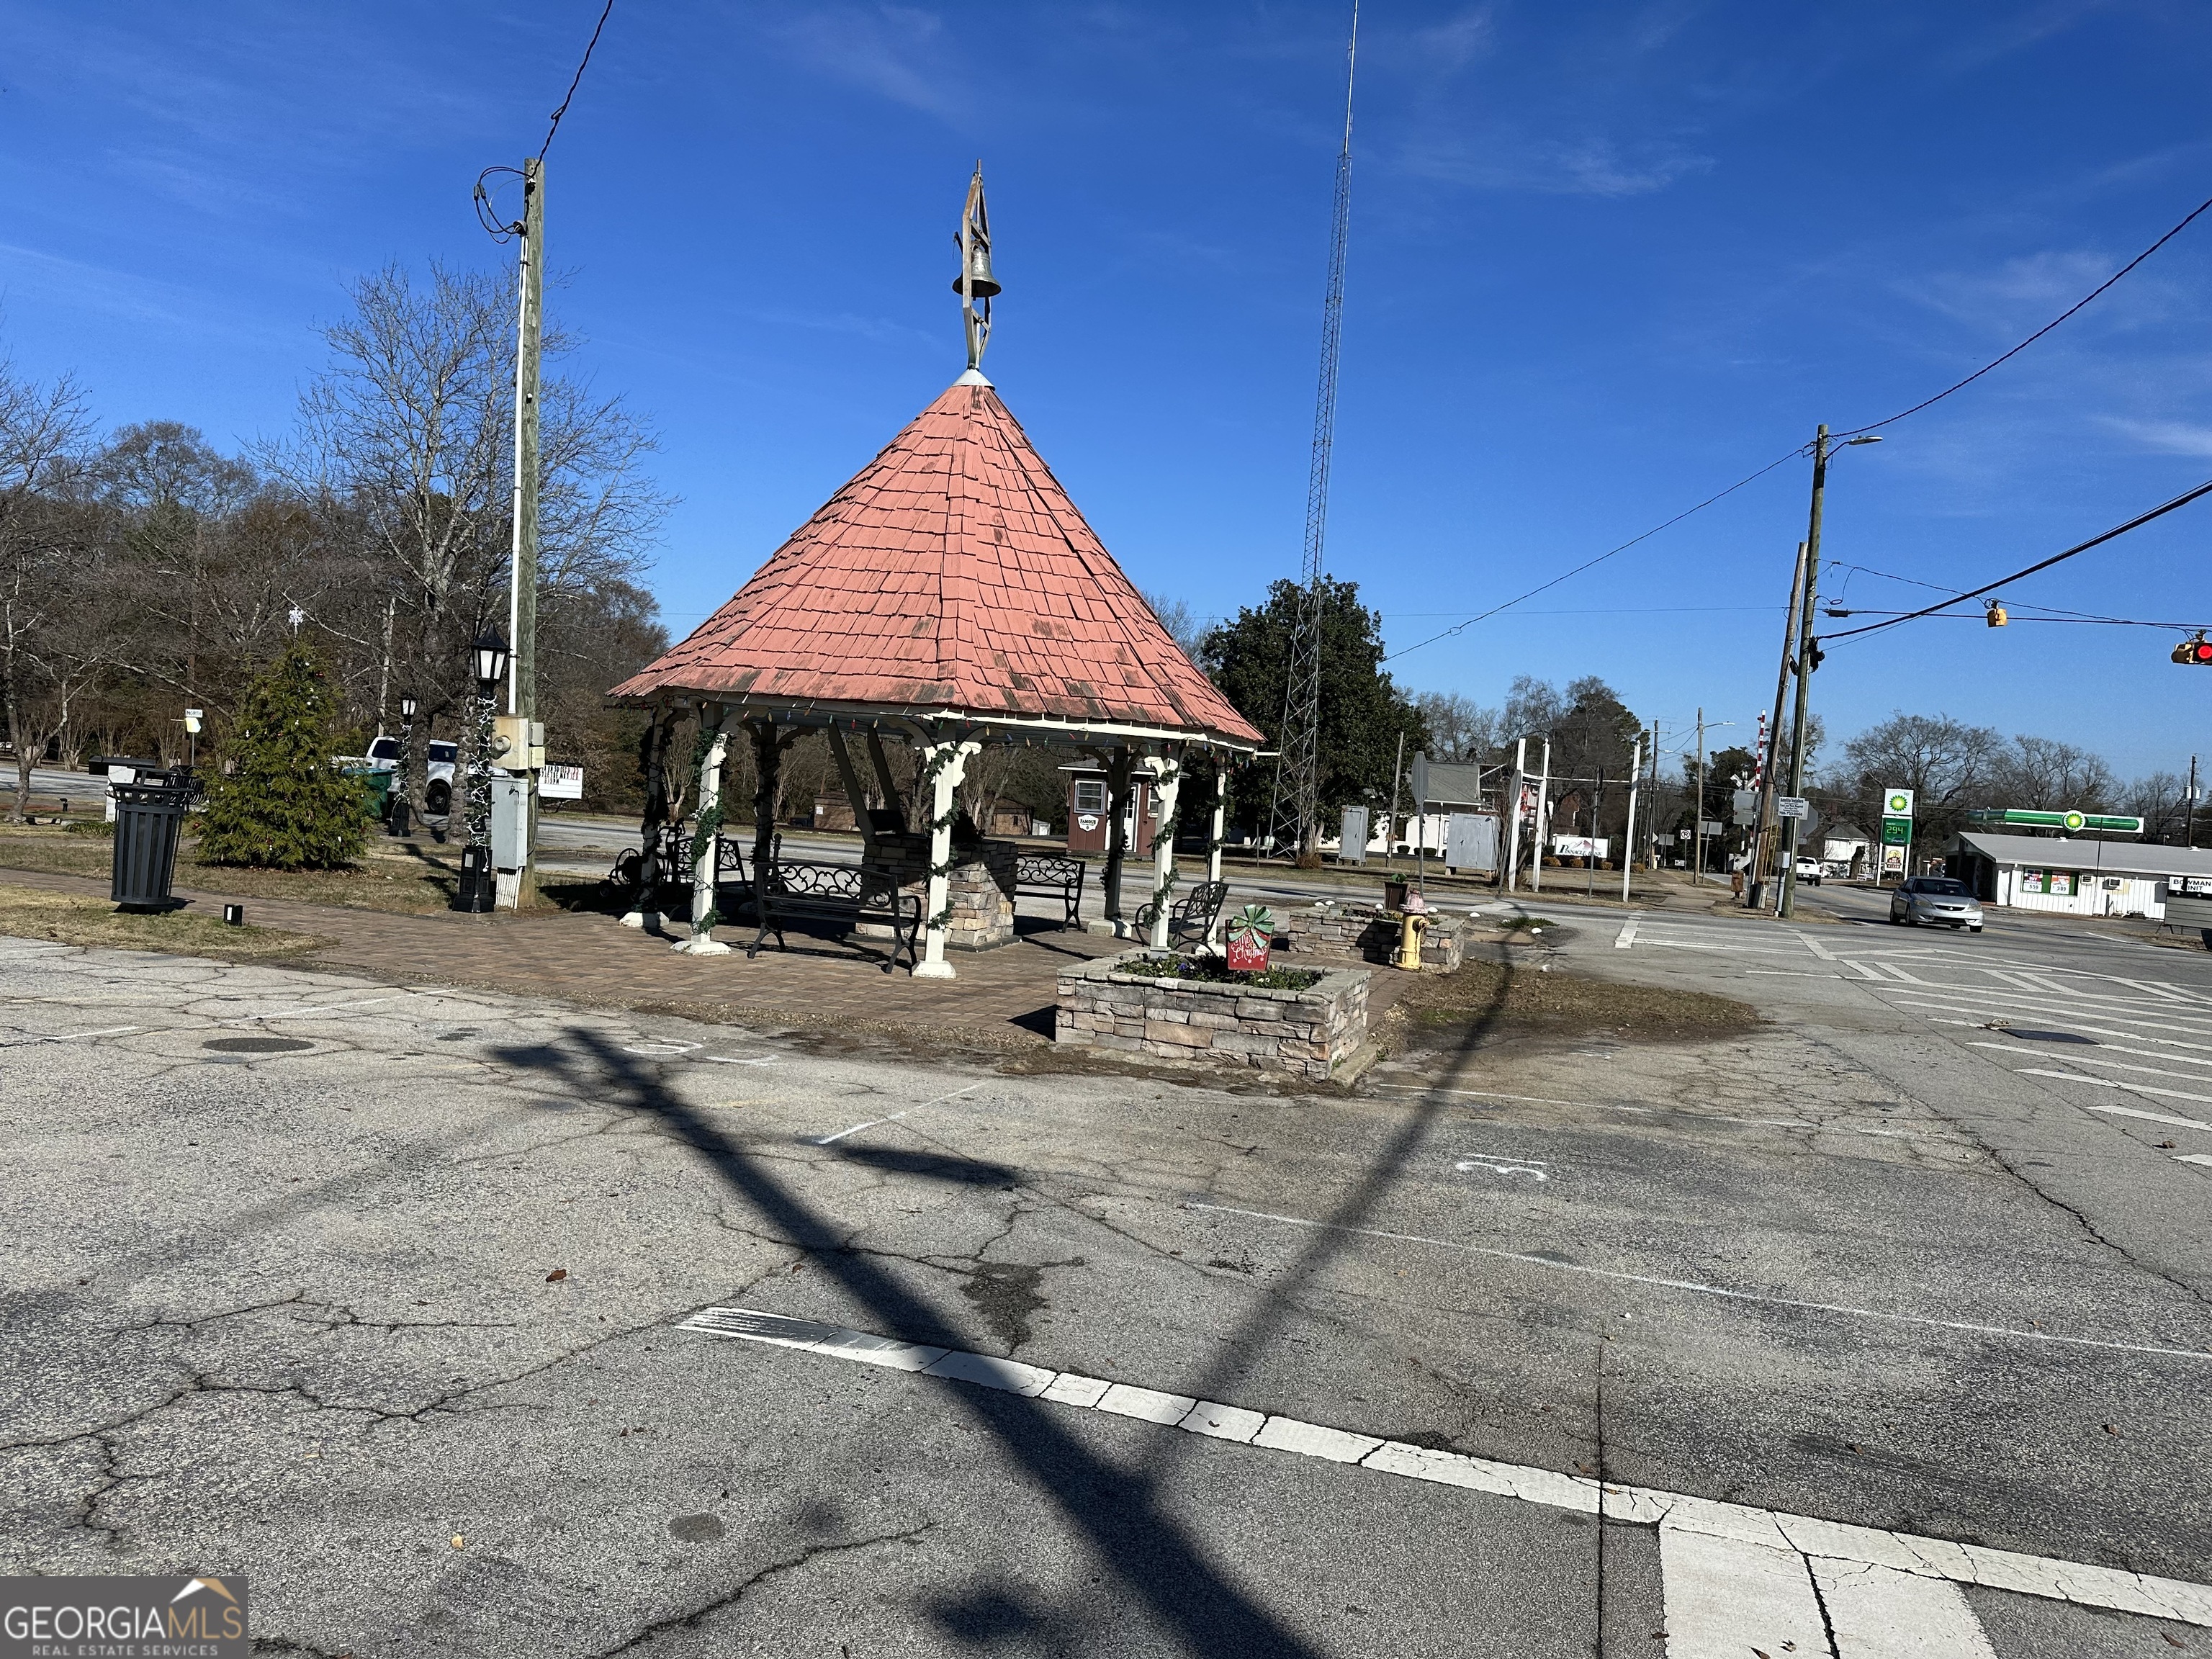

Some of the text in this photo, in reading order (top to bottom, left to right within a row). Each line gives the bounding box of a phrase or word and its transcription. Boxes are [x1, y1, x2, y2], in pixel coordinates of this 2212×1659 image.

[1559, 845, 1587, 855] PINNACLE
[1233, 934, 1256, 948] Mer
[1231, 944, 1267, 961] Christmas
